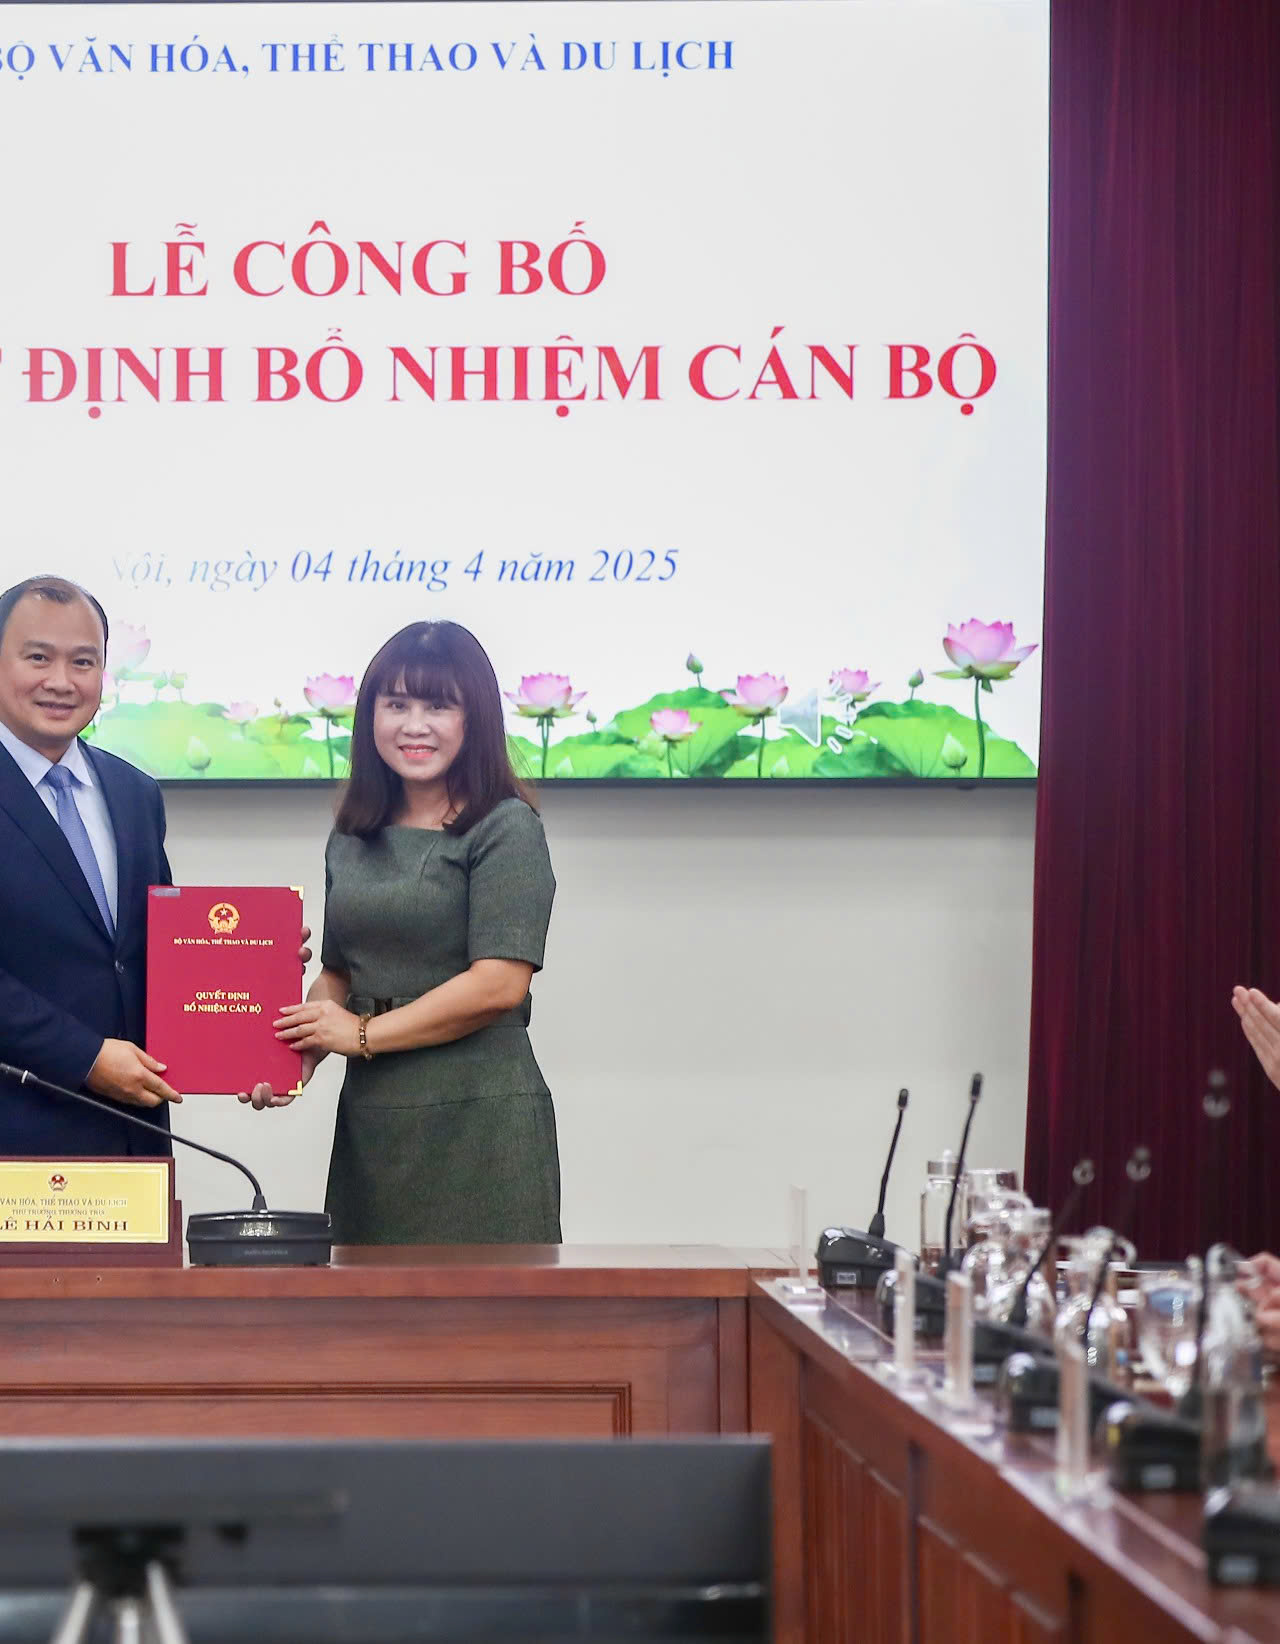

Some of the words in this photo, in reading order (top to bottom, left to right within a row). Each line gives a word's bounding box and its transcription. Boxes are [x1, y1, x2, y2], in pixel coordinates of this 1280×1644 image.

[48, 35, 134, 73] VĂN
[149, 34, 249, 79] HÓA,
[260, 33, 345, 73] THỂ
[358, 42, 478, 72] THAO
[490, 33, 547, 71] VÀ
[561, 41, 618, 71] DU
[631, 41, 734, 79] LỊCH
[109, 220, 210, 298] LỄ
[232, 218, 469, 298] CÔNG
[497, 219, 608, 298] BỐ
[22, 346, 226, 420] ĐỊNH
[254, 327, 365, 404] BỔ
[388, 336, 662, 420] NHIỆM
[688, 325, 858, 402] CÁN
[887, 331, 999, 418] BỘ
[188, 550, 279, 592] ngày
[290, 549, 336, 583] 04
[346, 548, 451, 593] tháng
[463, 550, 489, 584] 4
[496, 551, 577, 585] năm
[589, 549, 681, 586] 2025
[195, 989, 226, 1000] QUYẾT
[198, 1003, 227, 1014] NHIỆM
[229, 1003, 247, 1013] CÁN
[249, 1003, 262, 1014] BỘ
[57, 1198, 80, 1206] THAO
[25, 1215, 64, 1231] HẢI
[73, 1217, 128, 1231] BÌNH
